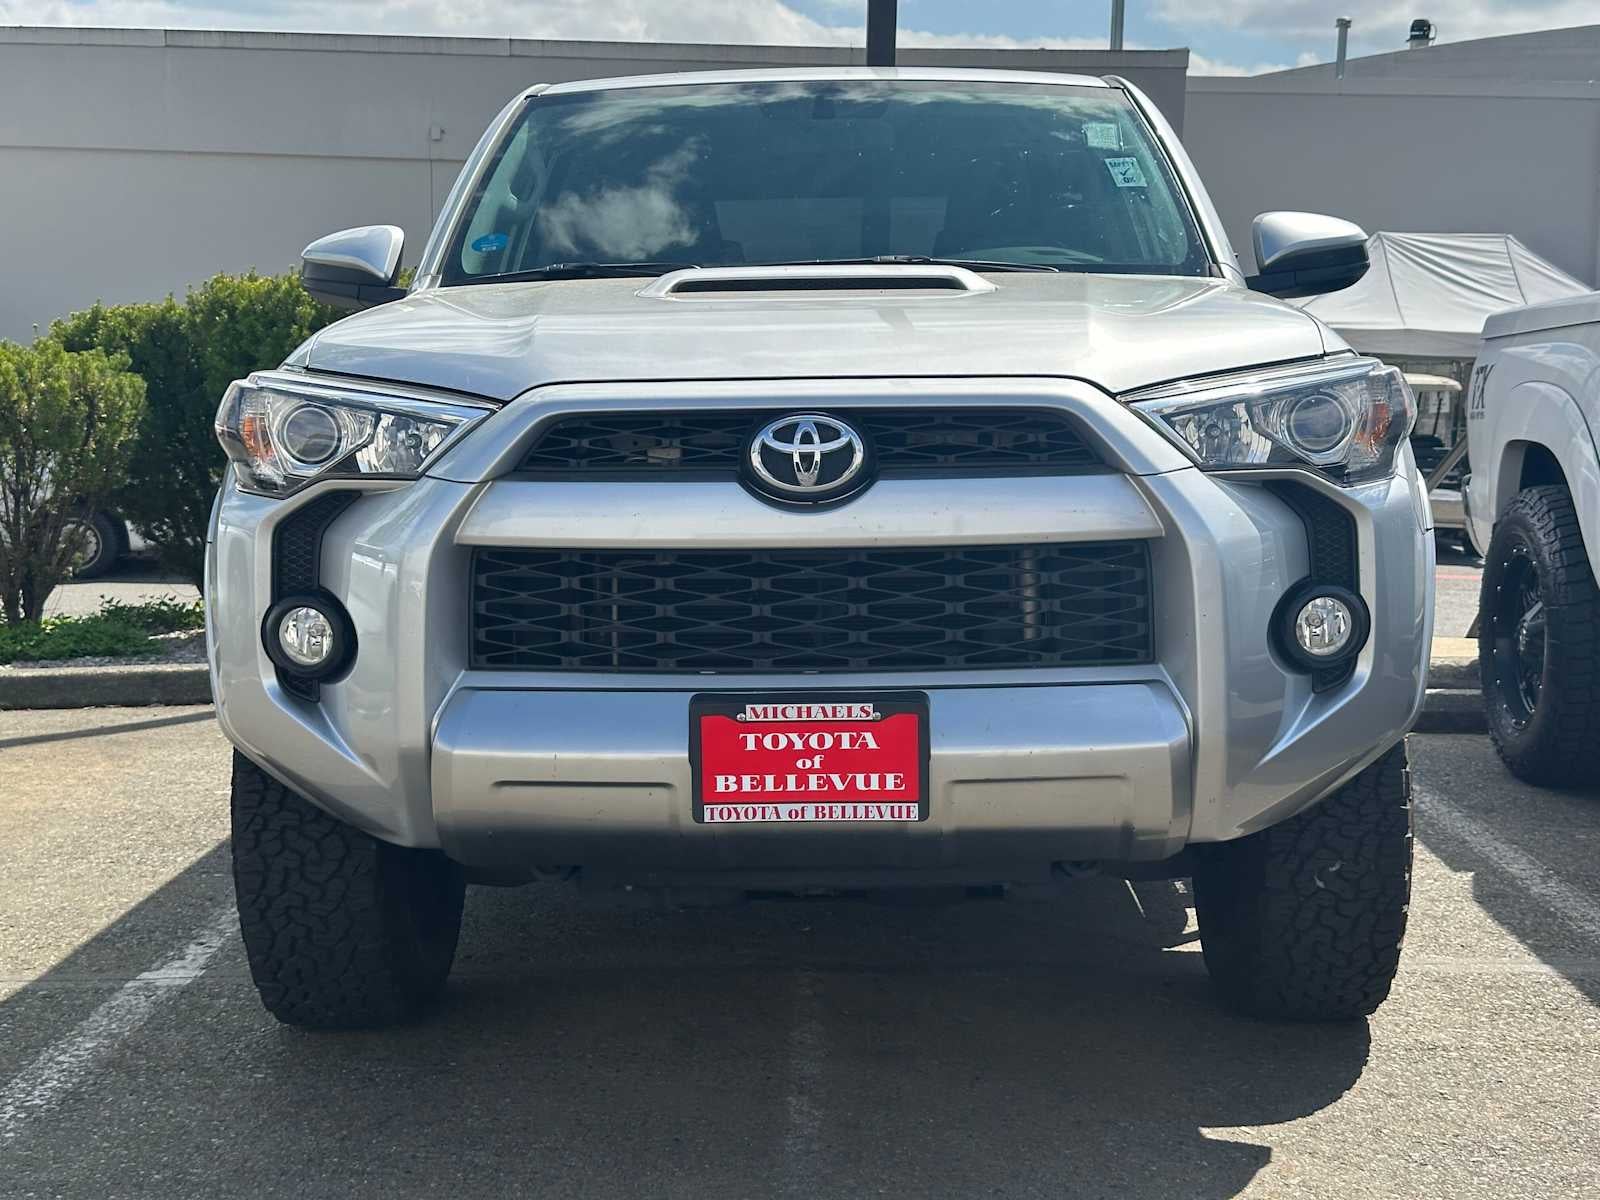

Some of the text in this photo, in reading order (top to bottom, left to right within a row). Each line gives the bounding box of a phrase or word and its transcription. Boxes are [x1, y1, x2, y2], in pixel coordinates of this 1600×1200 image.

[749, 705, 871, 719] MICHAELS
[739, 732, 880, 751] TOYOTA
[795, 754, 825, 769] of
[714, 773, 906, 793] BELLEVUE
[706, 805, 918, 821] TOYOTA of BELLEVUE
